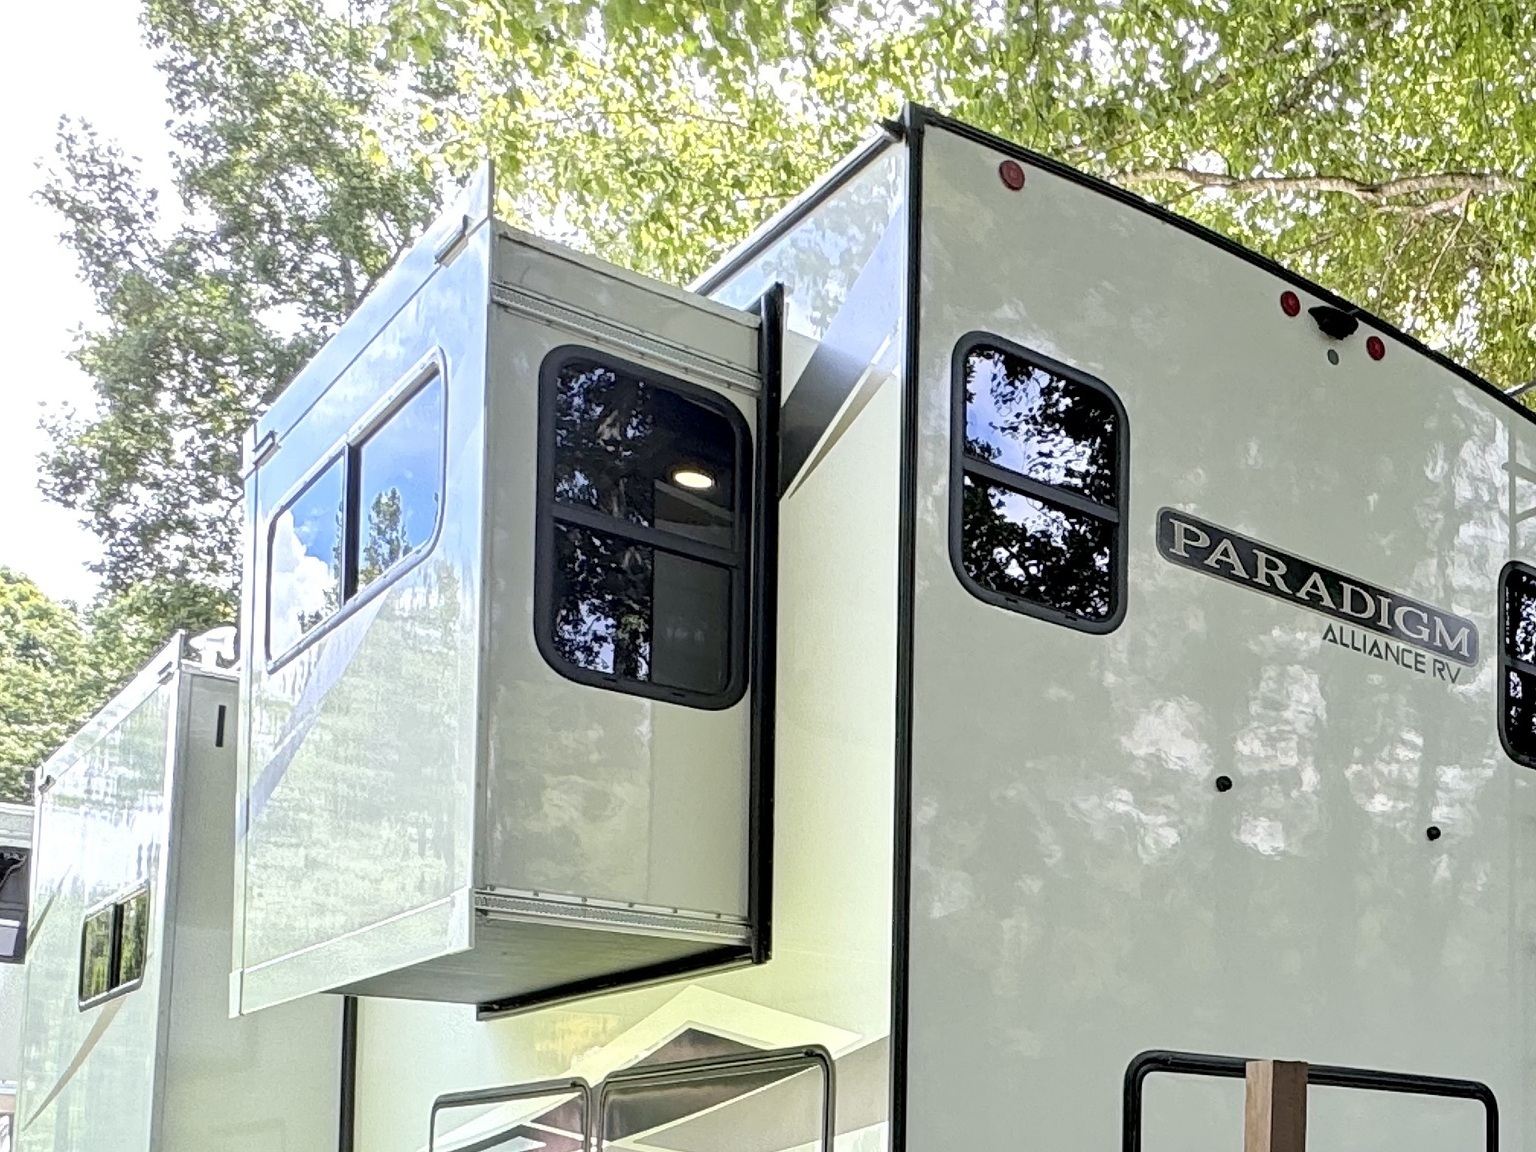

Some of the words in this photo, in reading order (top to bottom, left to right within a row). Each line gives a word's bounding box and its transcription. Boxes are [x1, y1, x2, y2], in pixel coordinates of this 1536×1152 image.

[1168, 517, 1471, 658] PARADIGM
[1321, 623, 1427, 673] ALLIANCE
[1431, 660, 1462, 685] RV
